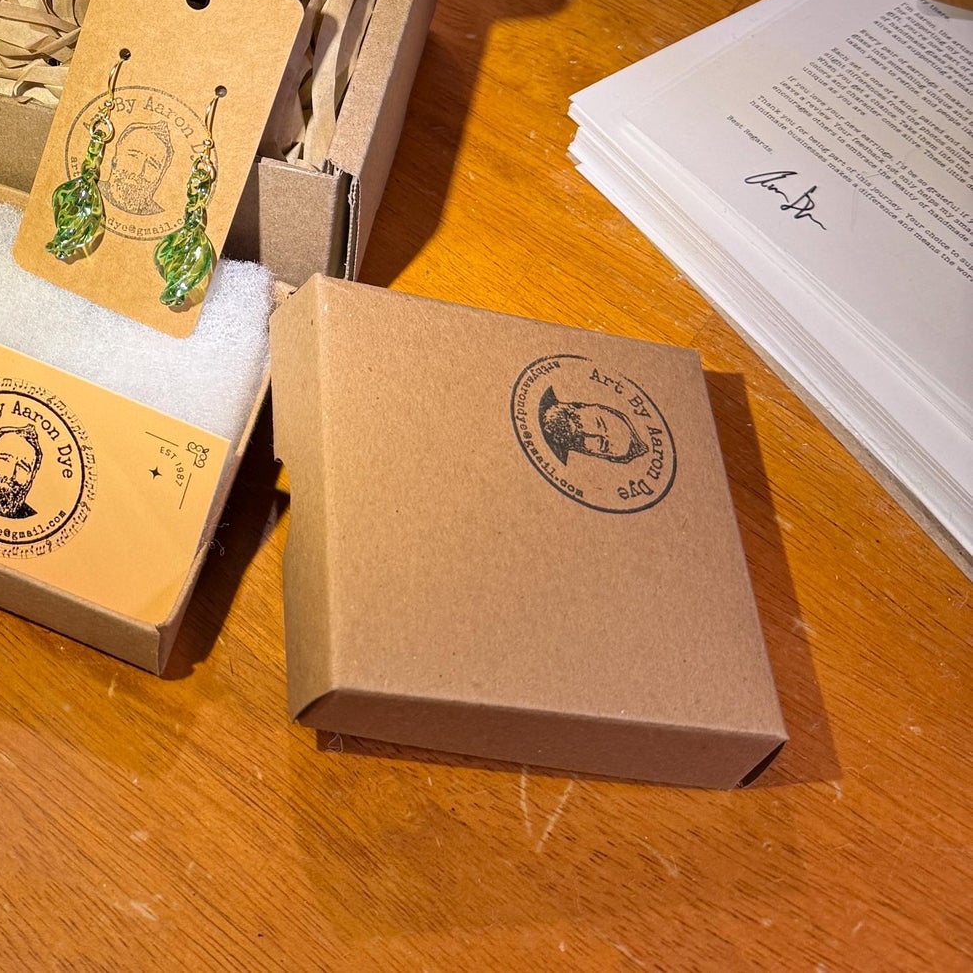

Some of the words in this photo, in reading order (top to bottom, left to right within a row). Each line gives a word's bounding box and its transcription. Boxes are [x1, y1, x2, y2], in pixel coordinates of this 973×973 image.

[114, 96, 137, 114] By
[143, 95, 195, 140] Aaron
[726, 114, 744, 130] Best
[771, 85, 814, 118] encourages
[811, 117, 838, 137] others
[844, 143, 878, 169] embrace
[876, 168, 892, 181] the
[890, 179, 920, 201] beauty
[926, 208, 970, 243] handmade
[793, 81, 811, 95] you
[808, 92, 827, 107] love
[824, 106, 846, 121] your
[843, 120, 862, 134] new
[895, 160, 909, 171] I'd
[925, 186, 961, 213] grateful
[749, 99, 788, 131] handmade
[786, 129, 828, 163] businesses
[826, 162, 854, 183] makes
[858, 187, 899, 220] difference
[896, 219, 915, 233] and
[913, 231, 942, 255] means
[940, 252, 956, 267] the
[589, 367, 625, 395] Art
[628, 393, 652, 419] By
[10, 399, 61, 442] Aaron
[56, 443, 74, 480] Dye
[645, 424, 664, 481] Aaron
[159, 446, 178, 460] EST
[174, 461, 185, 488] 1987
[616, 478, 655, 501] Dye
